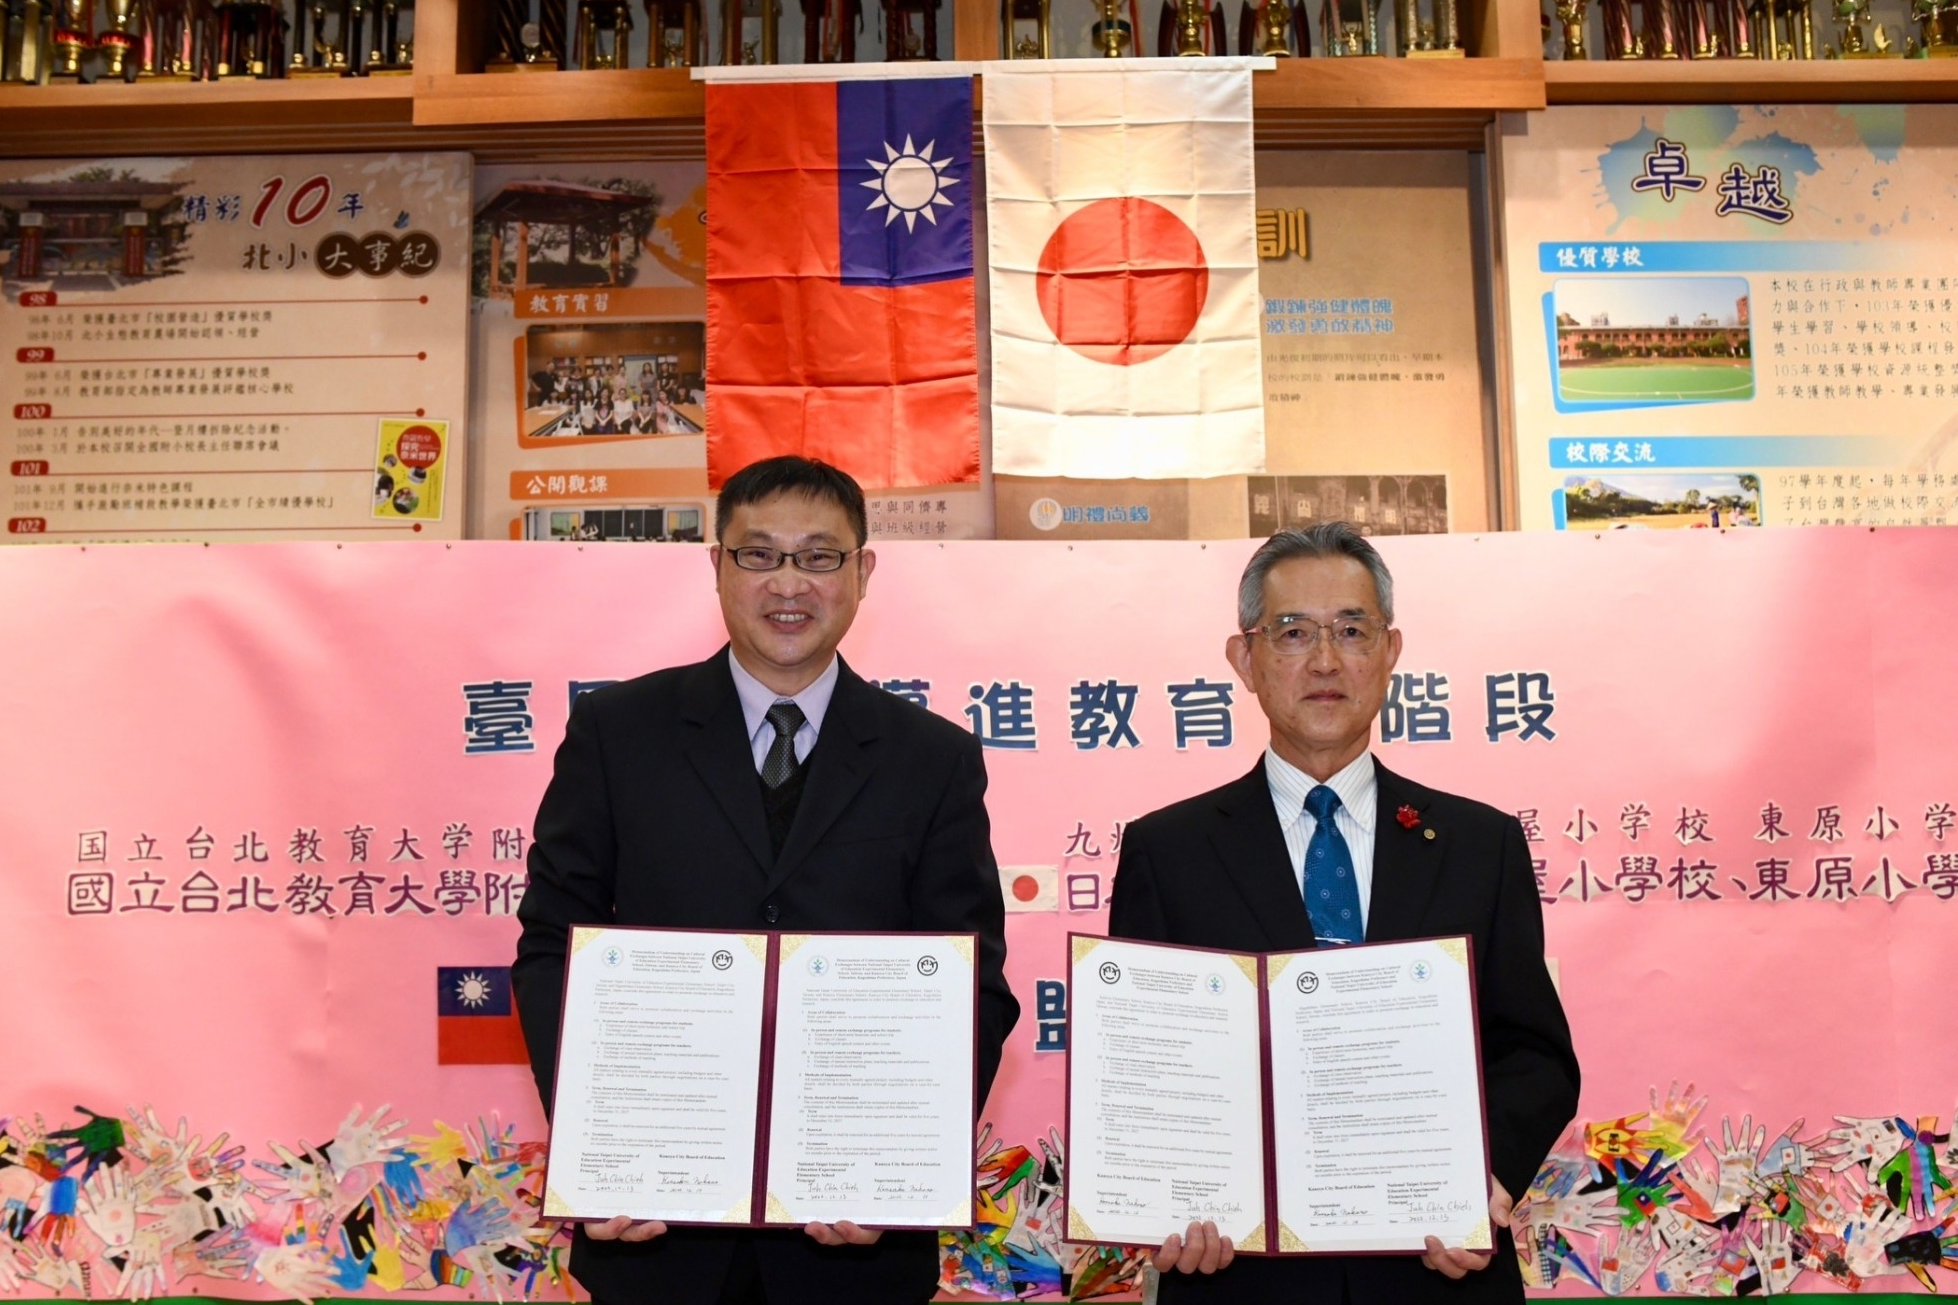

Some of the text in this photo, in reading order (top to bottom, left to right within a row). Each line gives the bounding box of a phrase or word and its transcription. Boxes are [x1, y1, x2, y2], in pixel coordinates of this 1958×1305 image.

[1633, 139, 1792, 223] 卓越
[1256, 207, 1307, 259] 訓
[242, 240, 433, 272] 北小大事紀
[1556, 246, 1644, 268] 優質學校
[530, 293, 609, 313] 教育實習
[20, 406, 47, 419] 100
[1566, 441, 1656, 464] 校際交流
[19, 462, 42, 475] 101
[526, 475, 608, 495] 公開觀課
[16, 518, 41, 532] 102
[868, 678, 1234, 749] 進教育
[1380, 672, 1556, 743] 階段
[78, 822, 526, 864] 国立台北教育大学附
[1757, 802, 1958, 842] 東原小学
[68, 869, 530, 917] 國立台北教育大學附
